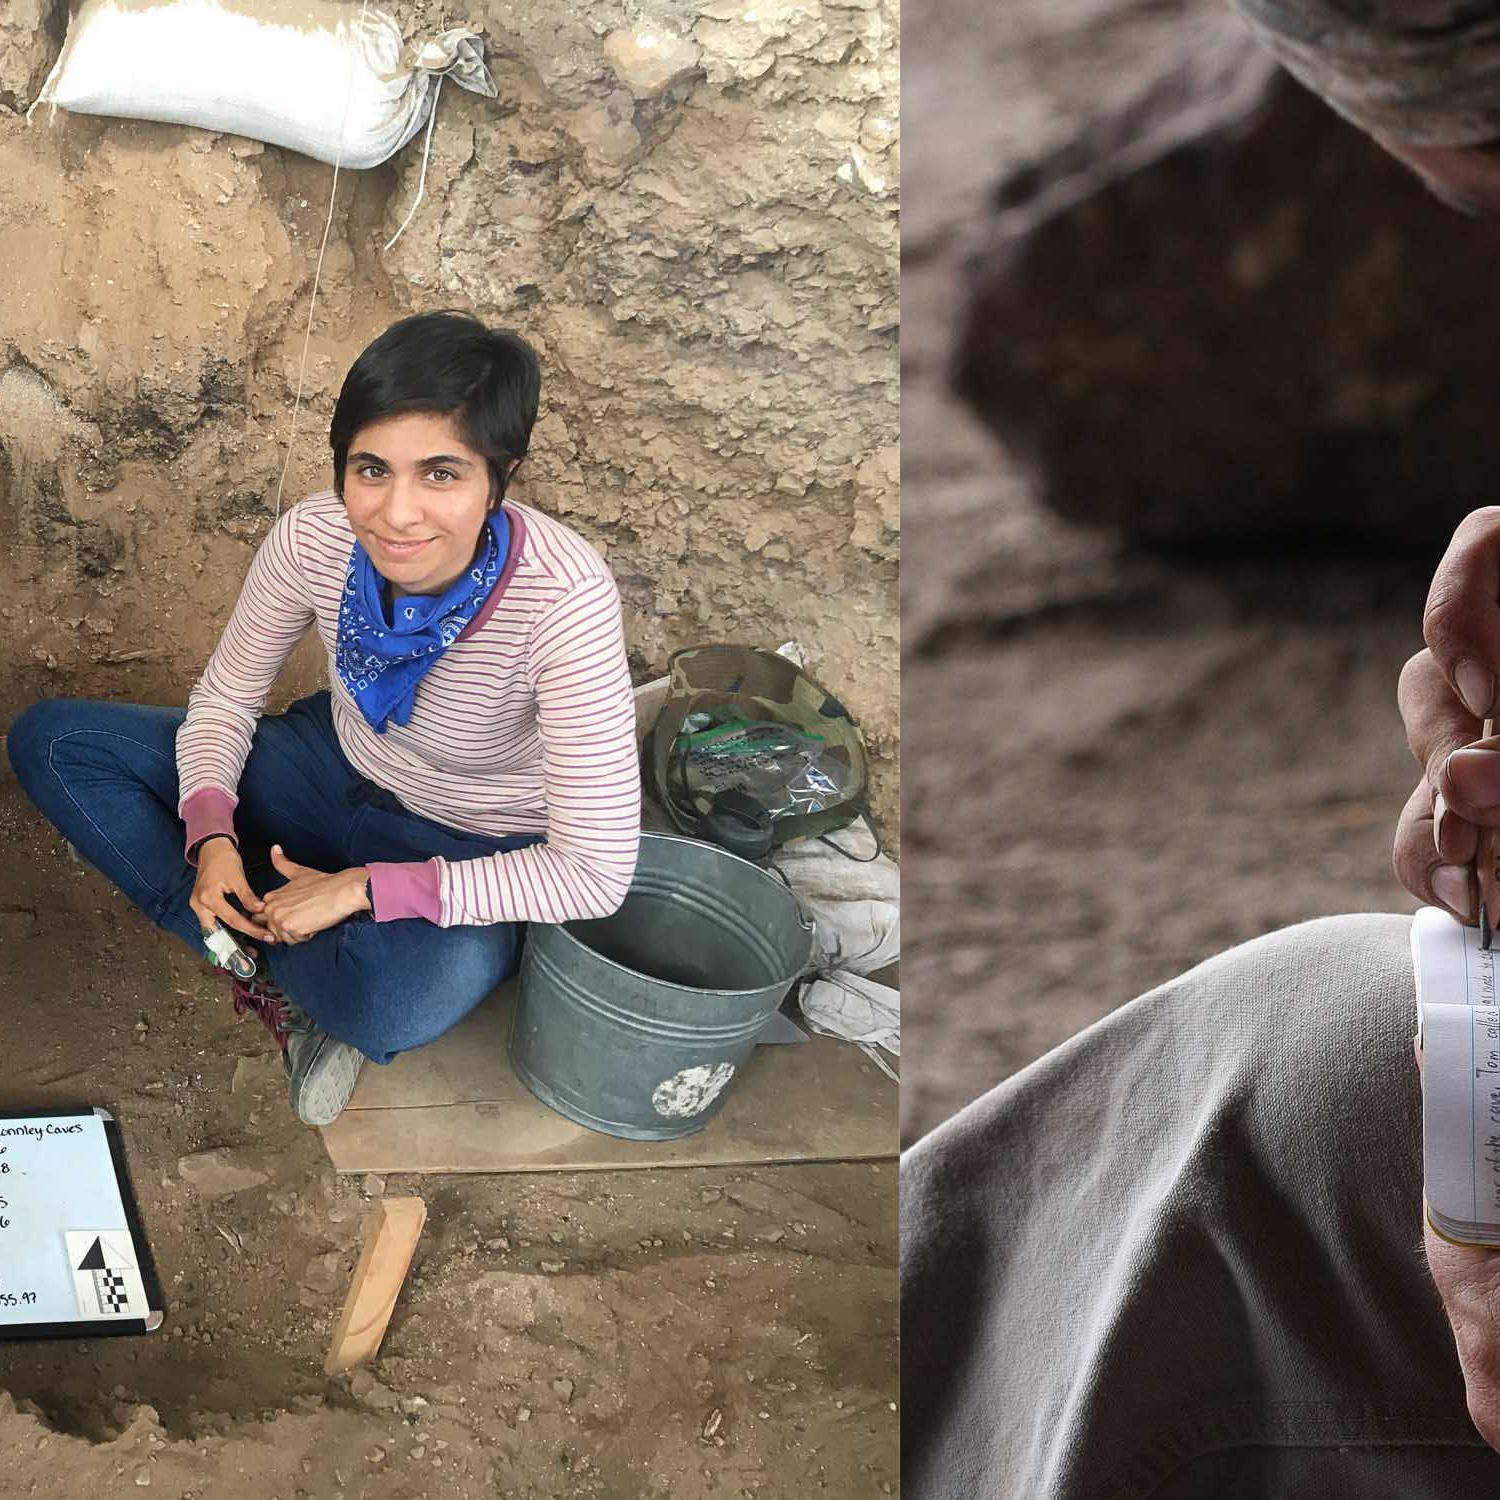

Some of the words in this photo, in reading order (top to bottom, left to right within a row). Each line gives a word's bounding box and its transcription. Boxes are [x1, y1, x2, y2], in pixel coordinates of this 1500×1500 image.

[1476, 1011, 1500, 1039] called
[1476, 1050, 1499, 1079] Tom
[46, 1124, 83, 1134] Caves
